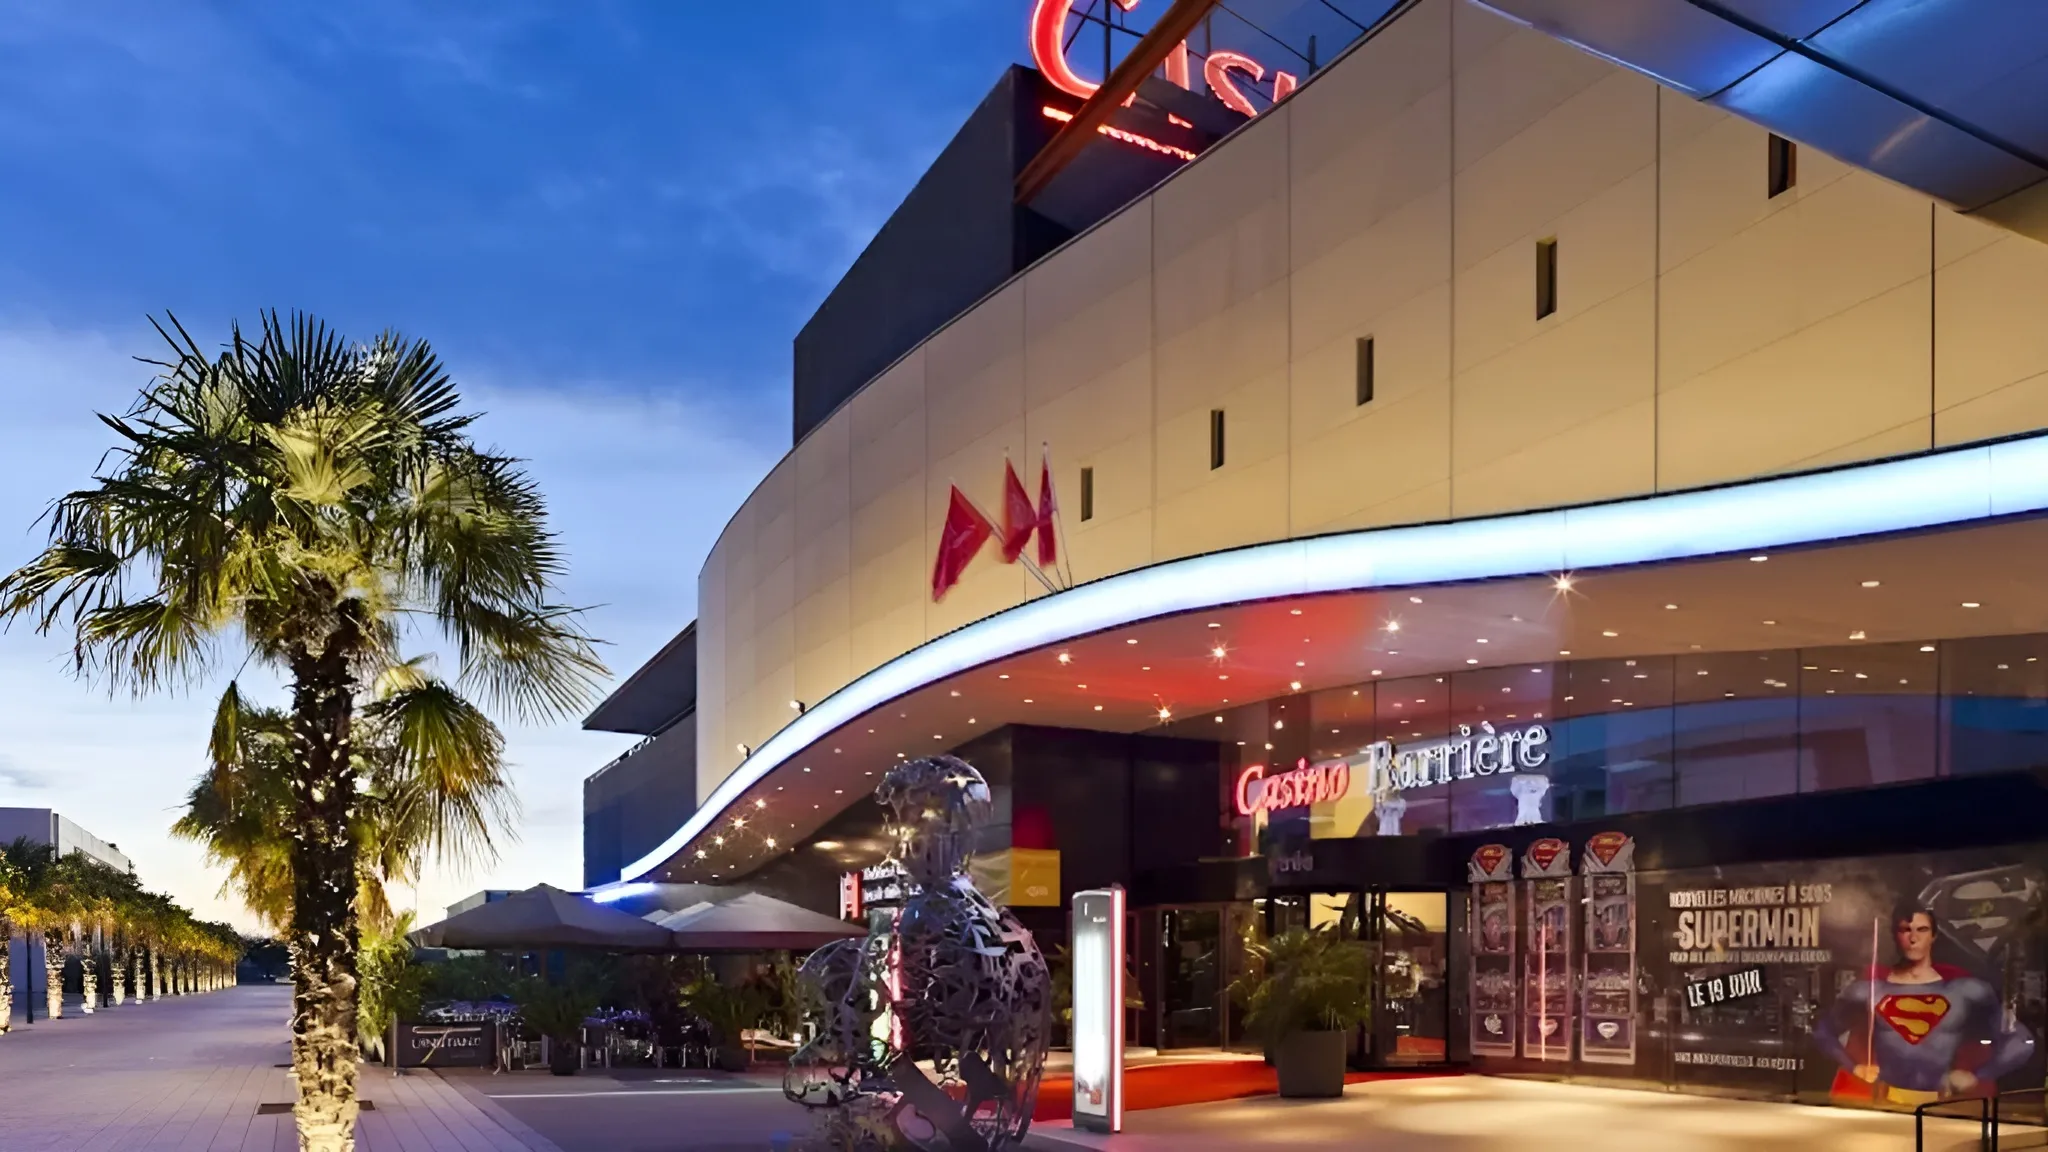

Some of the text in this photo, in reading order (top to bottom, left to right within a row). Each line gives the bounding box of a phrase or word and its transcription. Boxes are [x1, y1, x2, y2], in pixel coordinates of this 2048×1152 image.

[1236, 721, 1551, 815] Casino Barrière
[1673, 906, 1820, 950] SUPERMAN
[1687, 969, 1763, 1008] LE 19 JUIN
